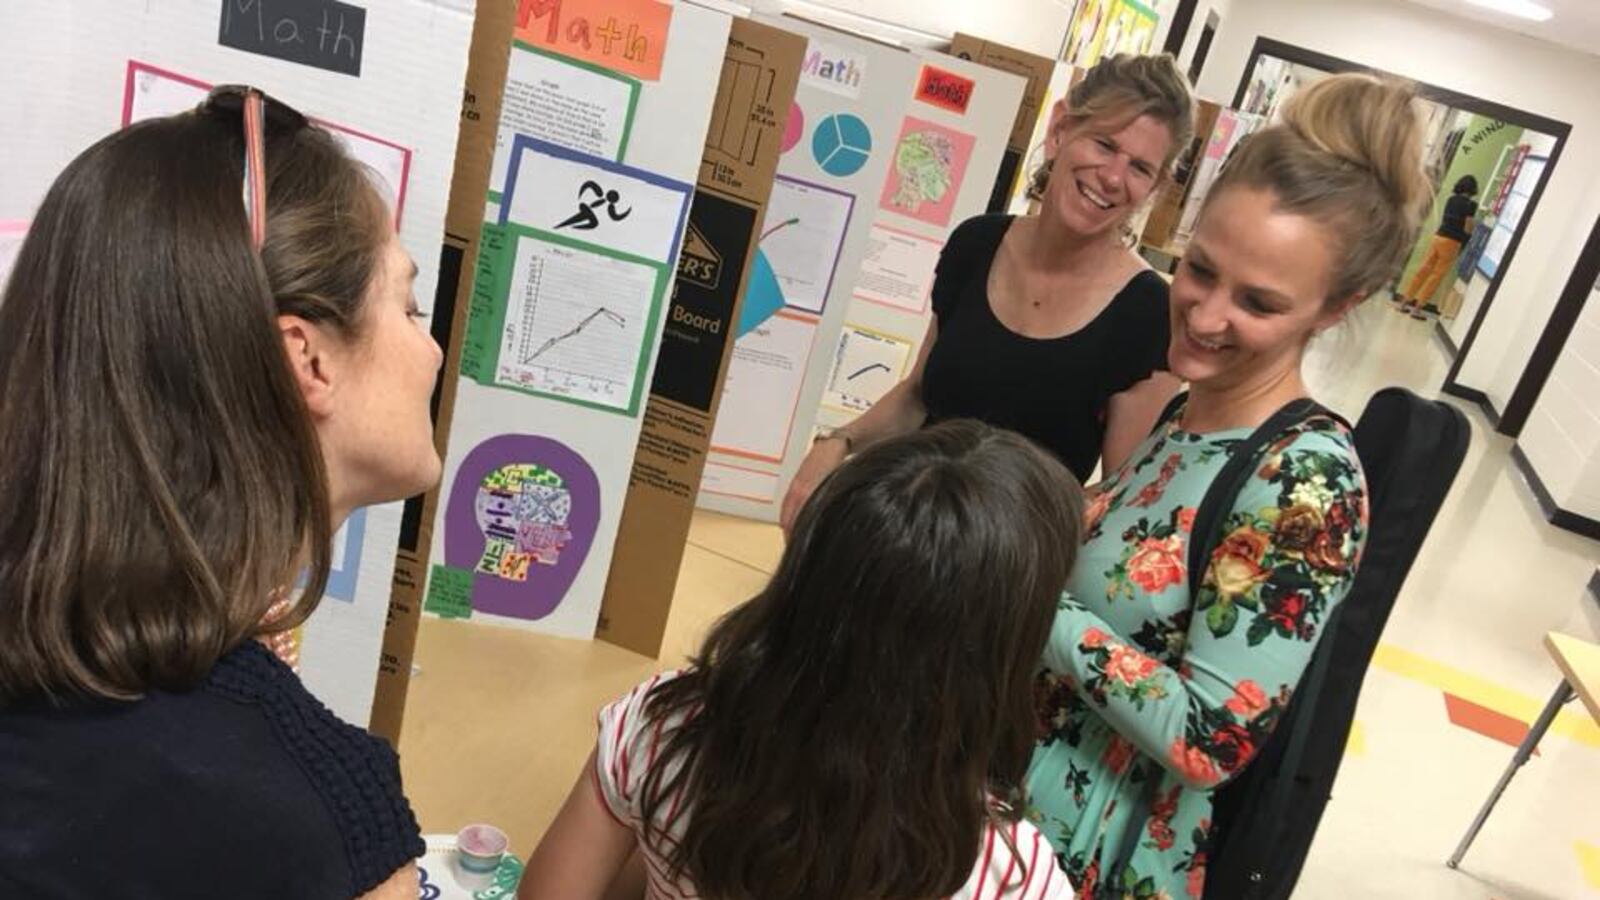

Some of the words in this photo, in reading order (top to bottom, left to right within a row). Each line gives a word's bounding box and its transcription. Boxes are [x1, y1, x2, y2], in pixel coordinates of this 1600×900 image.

[224, 0, 355, 58] Math
[515, 0, 648, 62] Math
[802, 51, 861, 87] Math
[673, 304, 721, 334] Board
